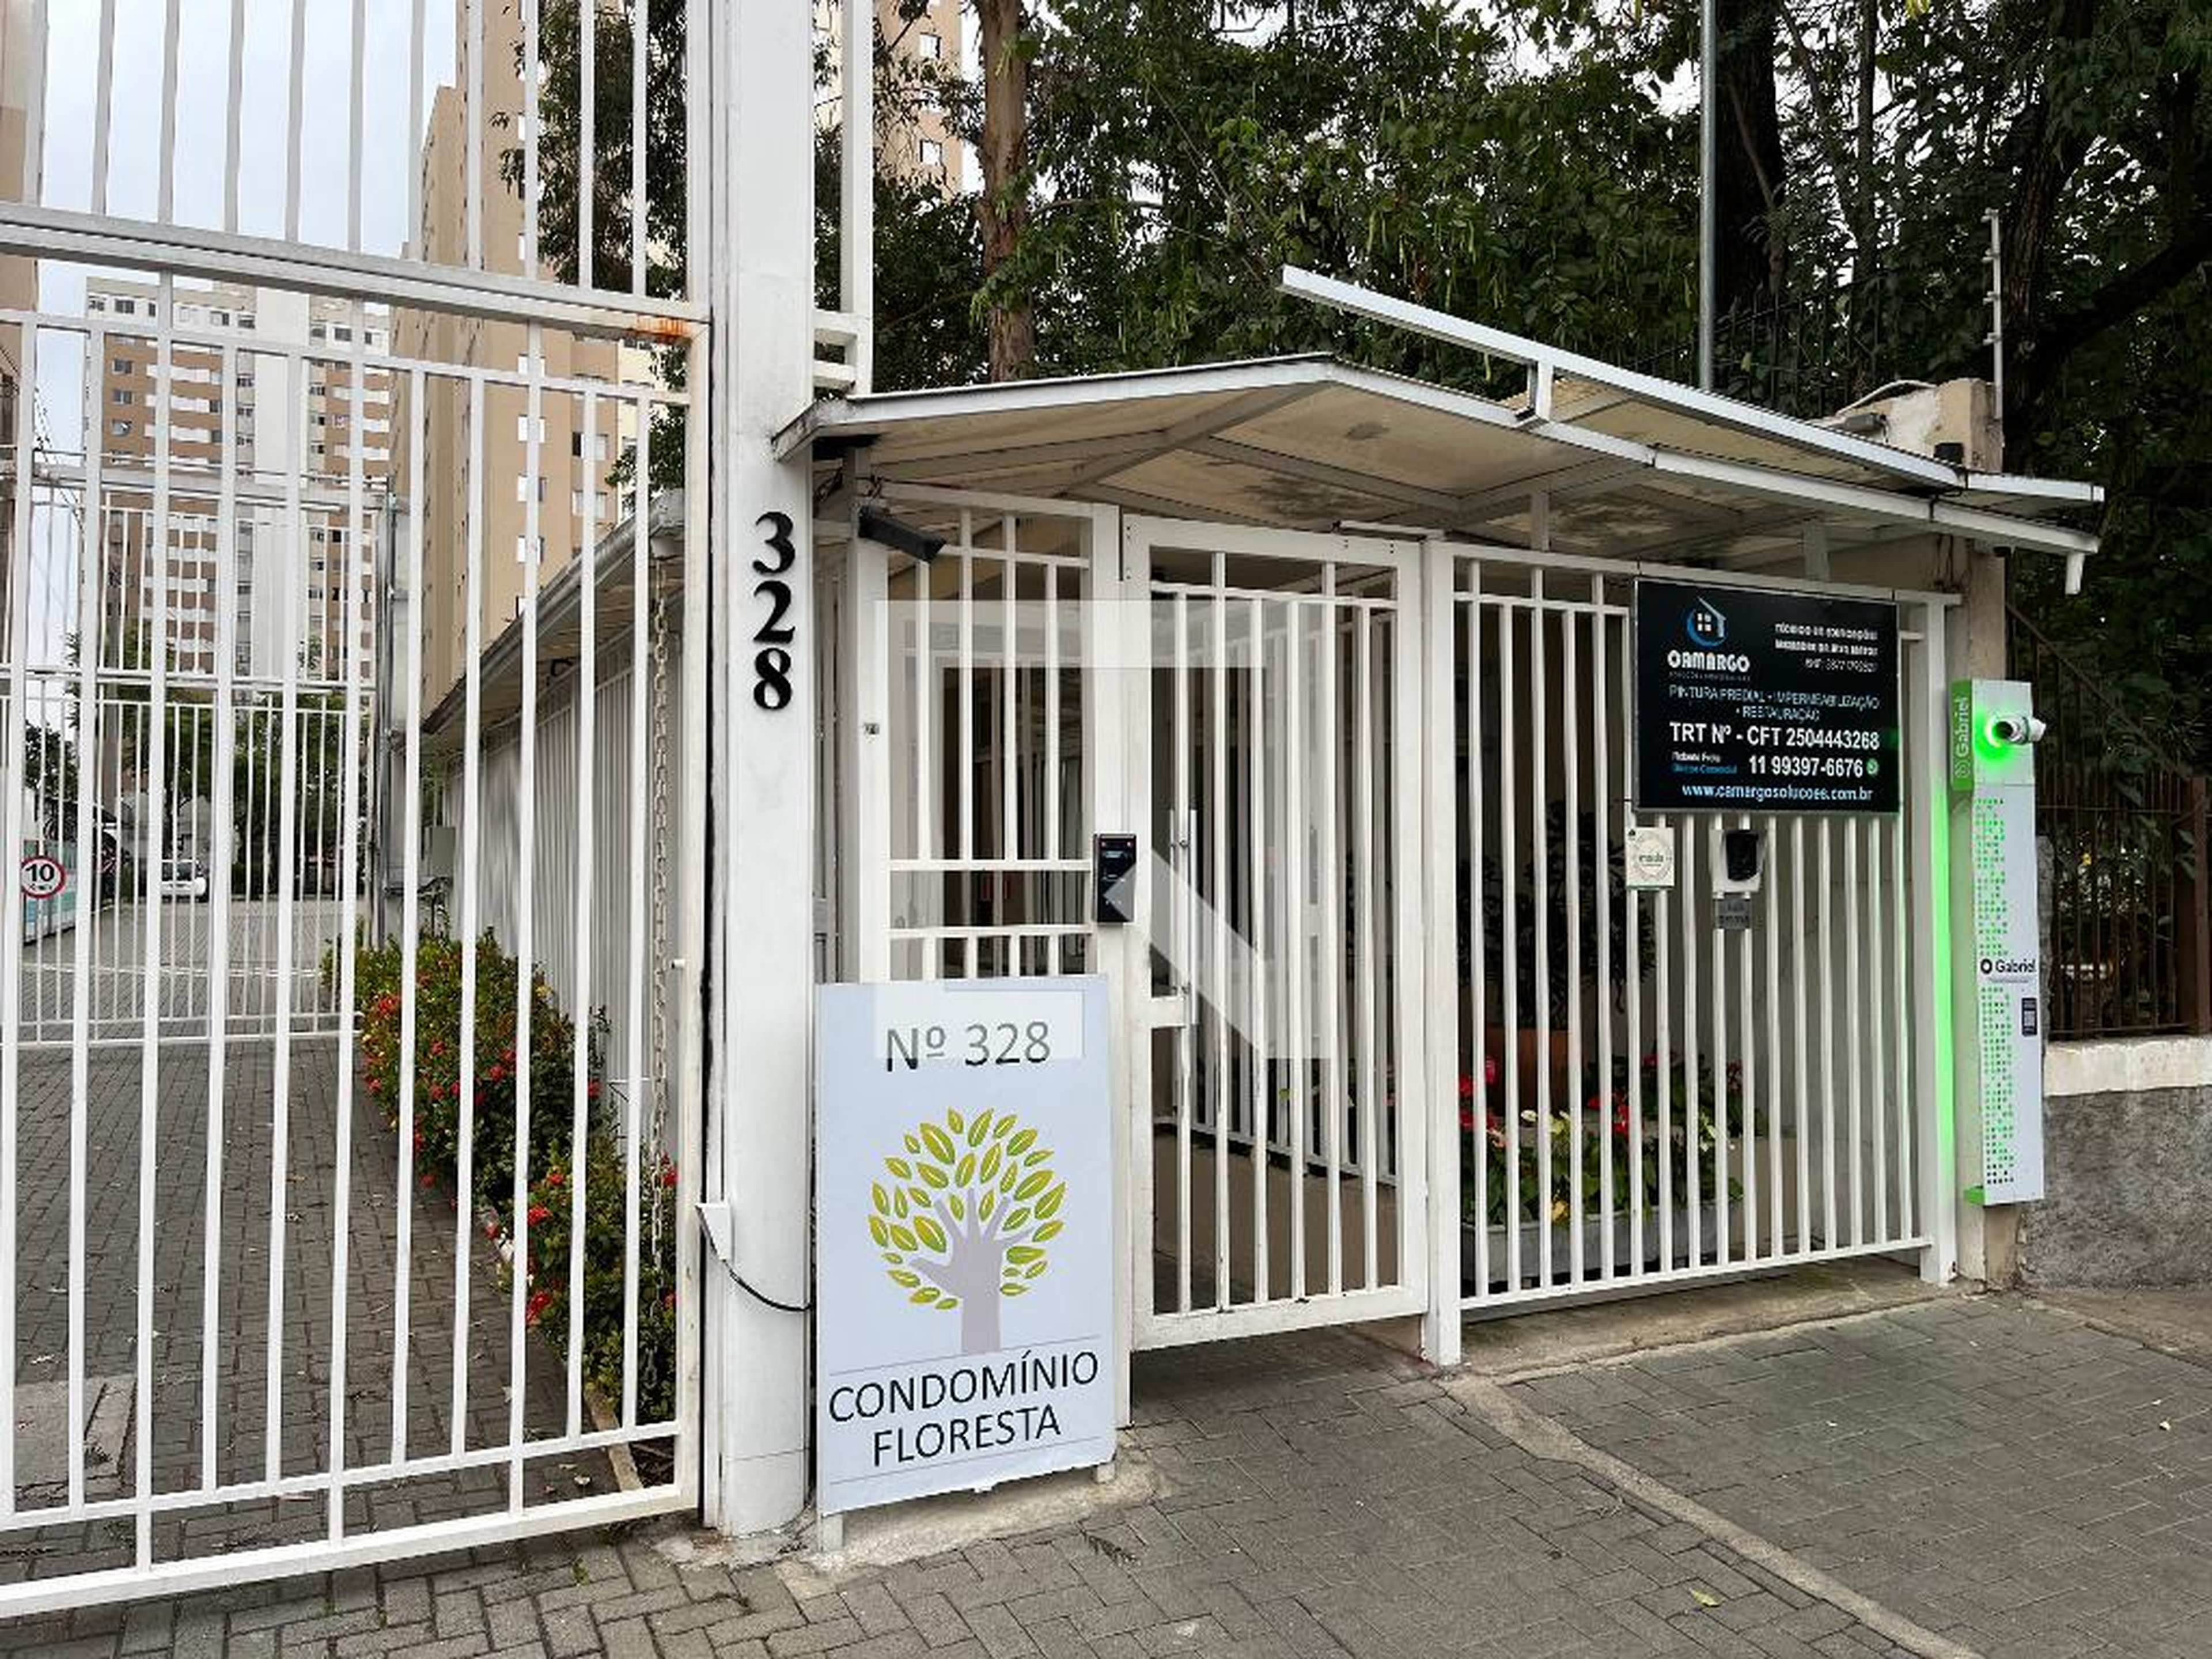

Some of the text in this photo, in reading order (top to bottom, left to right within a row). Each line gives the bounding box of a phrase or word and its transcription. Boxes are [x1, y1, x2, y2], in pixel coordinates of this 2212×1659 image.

[753, 512, 796, 710] 328
[1670, 722, 1707, 743] TRT
[1747, 725, 1782, 747] CFT
[1786, 728, 1880, 750] 2504443268
[1955, 696, 1969, 757] Gabriel
[1749, 755, 1766, 774] 11
[1771, 756, 1863, 777] 99397-6676
[26, 864, 54, 881] 10
[1996, 959, 2036, 972] Gabriel
[965, 1021, 1050, 1066] 328
[830, 1350, 1098, 1422] CONDOMÍNIO
[874, 1404, 1060, 1467] FLORESTA
